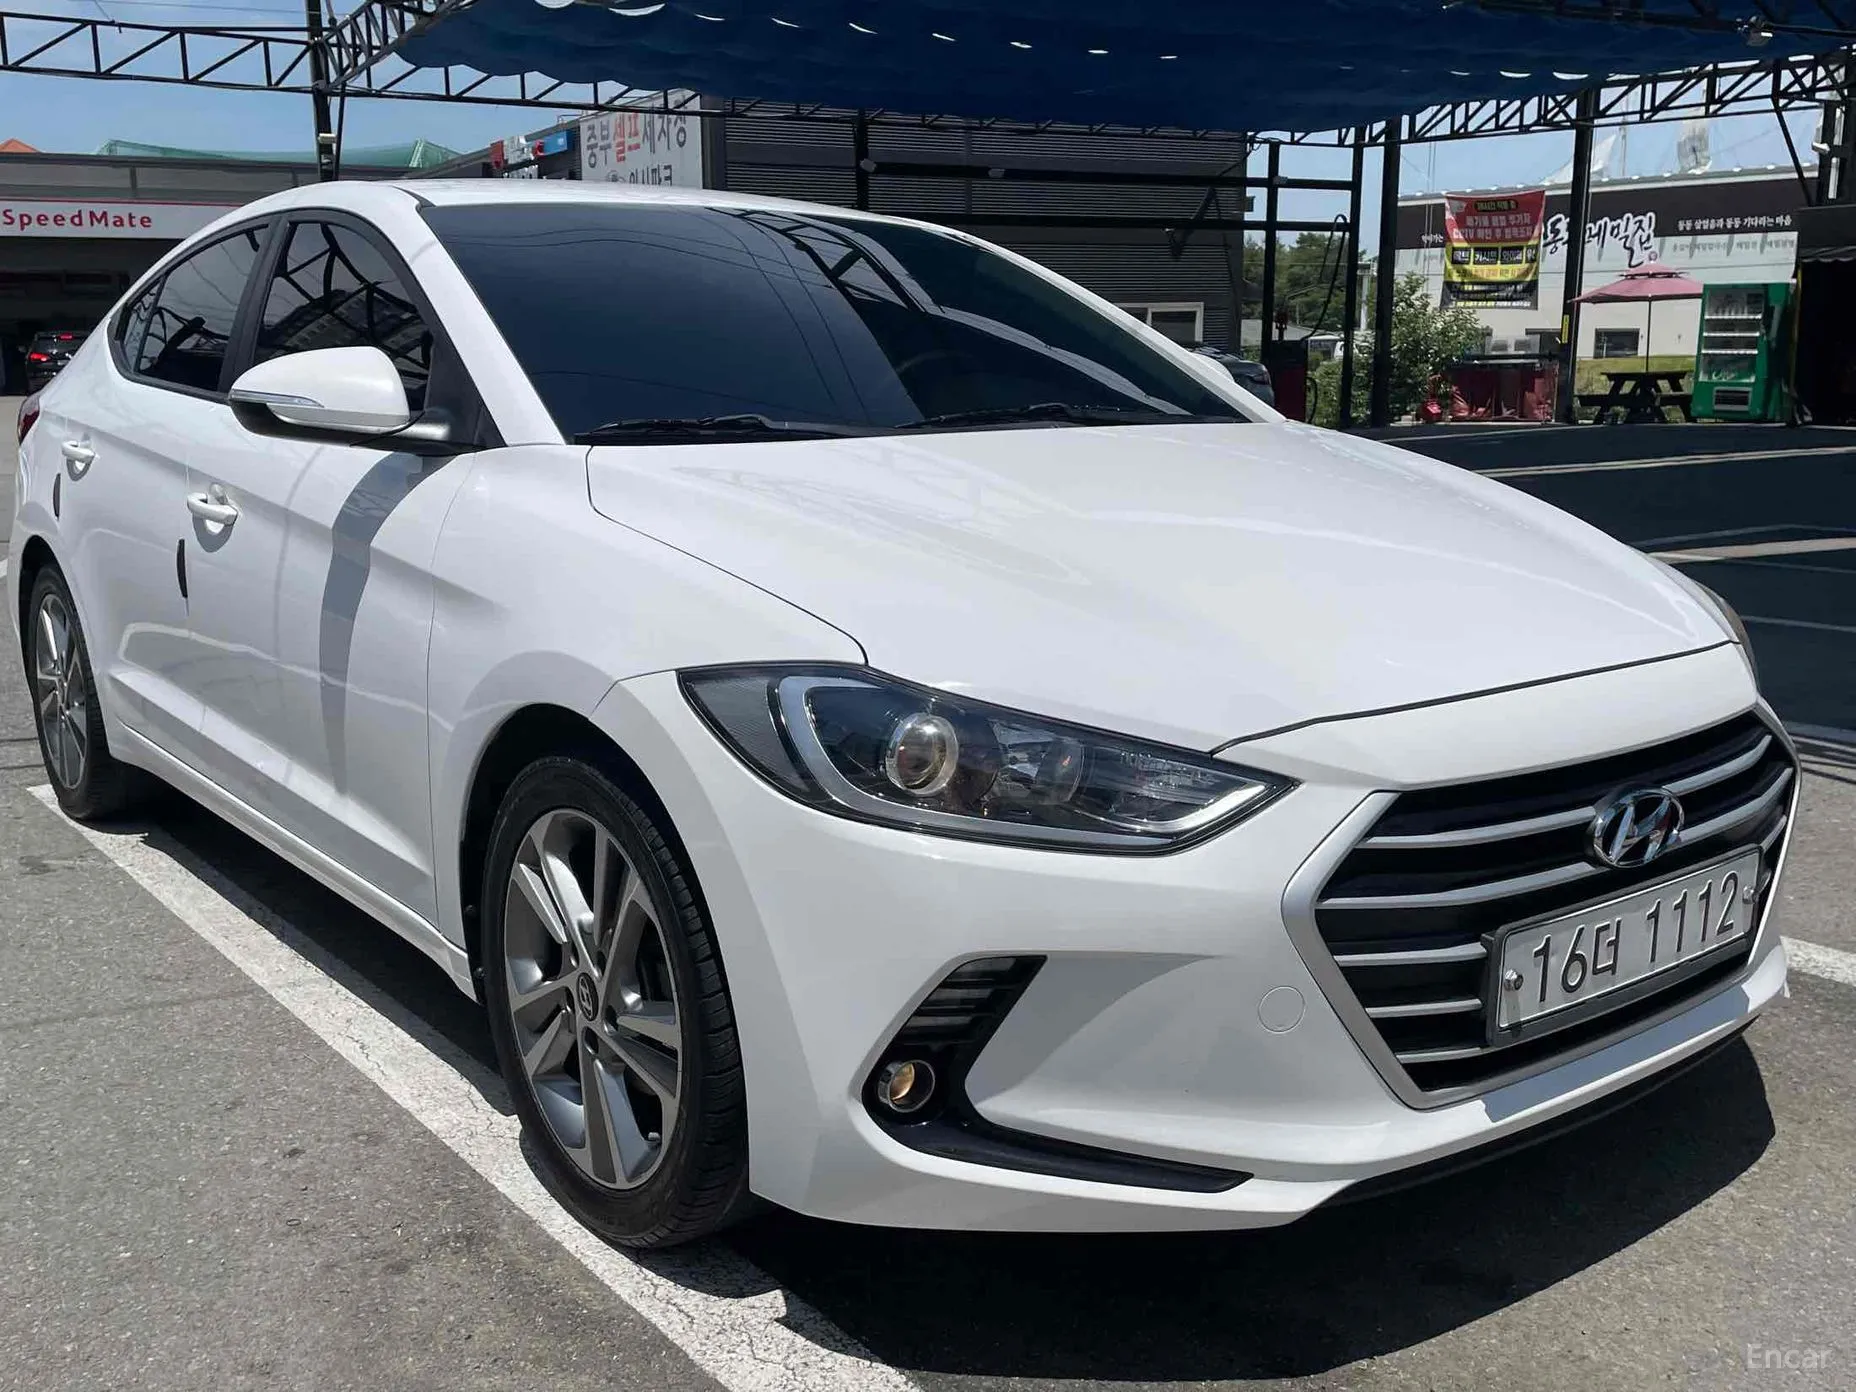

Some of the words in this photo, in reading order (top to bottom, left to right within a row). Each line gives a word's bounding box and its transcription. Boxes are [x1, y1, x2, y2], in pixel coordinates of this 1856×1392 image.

[1543, 214, 1653, 269] 동메밀집
[1743, 215, 1774, 228] 기다리는
[1533, 917, 1622, 1003] 16더
[1645, 871, 1739, 964] 1112
